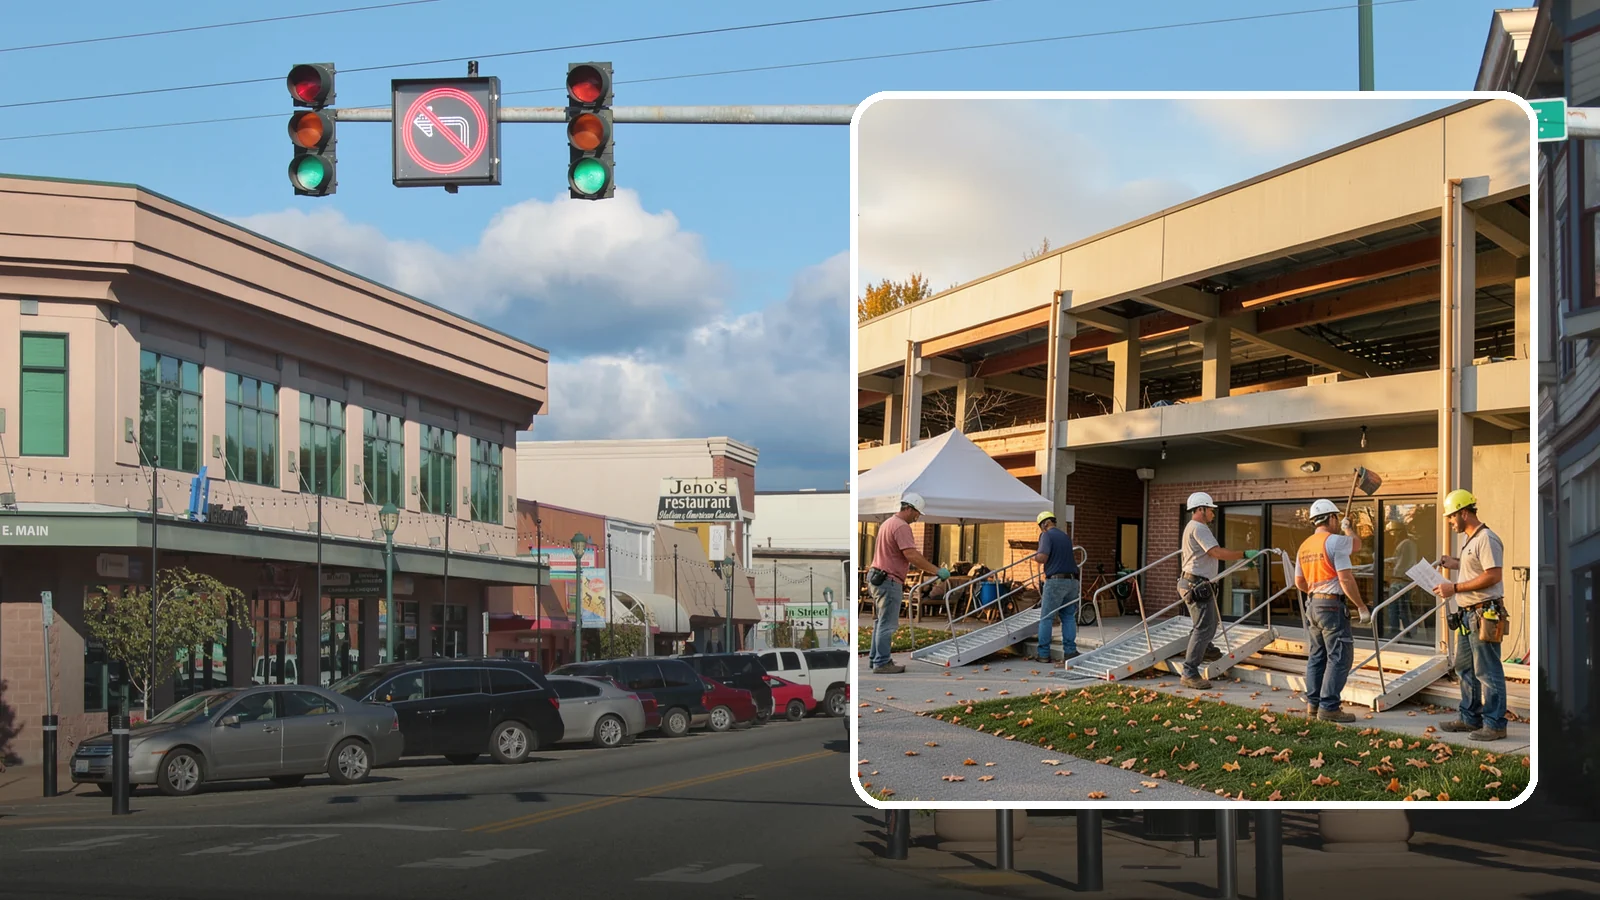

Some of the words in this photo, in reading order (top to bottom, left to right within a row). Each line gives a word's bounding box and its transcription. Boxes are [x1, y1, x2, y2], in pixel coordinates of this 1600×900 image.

[670, 480, 727, 494] Jeno's
[665, 496, 731, 509] restaurant
[658, 510, 682, 520] Italian
[686, 510, 714, 519] American
[715, 510, 737, 519] Cuisine
[2, 525, 13, 536] E.
[15, 525, 49, 536] MAIN
[797, 607, 828, 617] Street
[790, 619, 823, 627] lass
